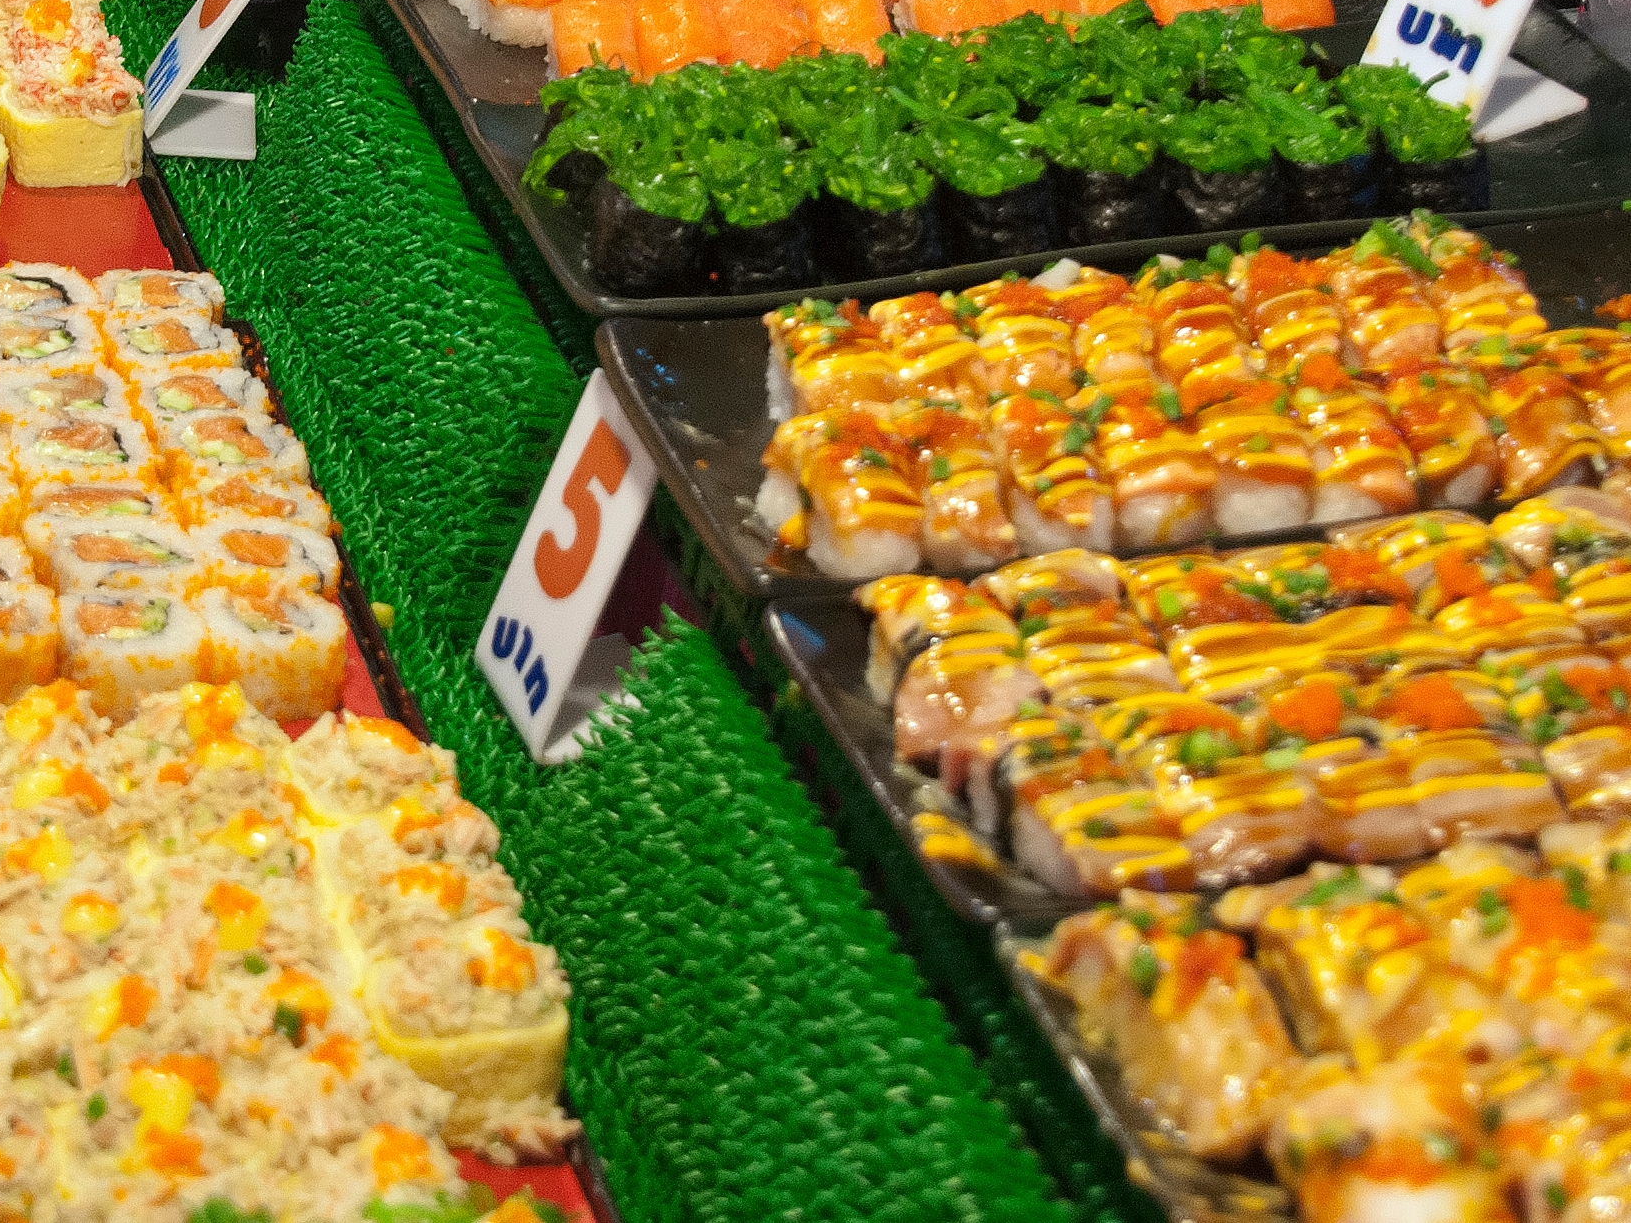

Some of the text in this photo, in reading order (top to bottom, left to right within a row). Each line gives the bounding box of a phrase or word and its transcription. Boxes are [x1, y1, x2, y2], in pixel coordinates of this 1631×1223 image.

[1396, 3, 1484, 75] บาท
[534, 416, 632, 600] 5
[491, 615, 549, 717] บาท
